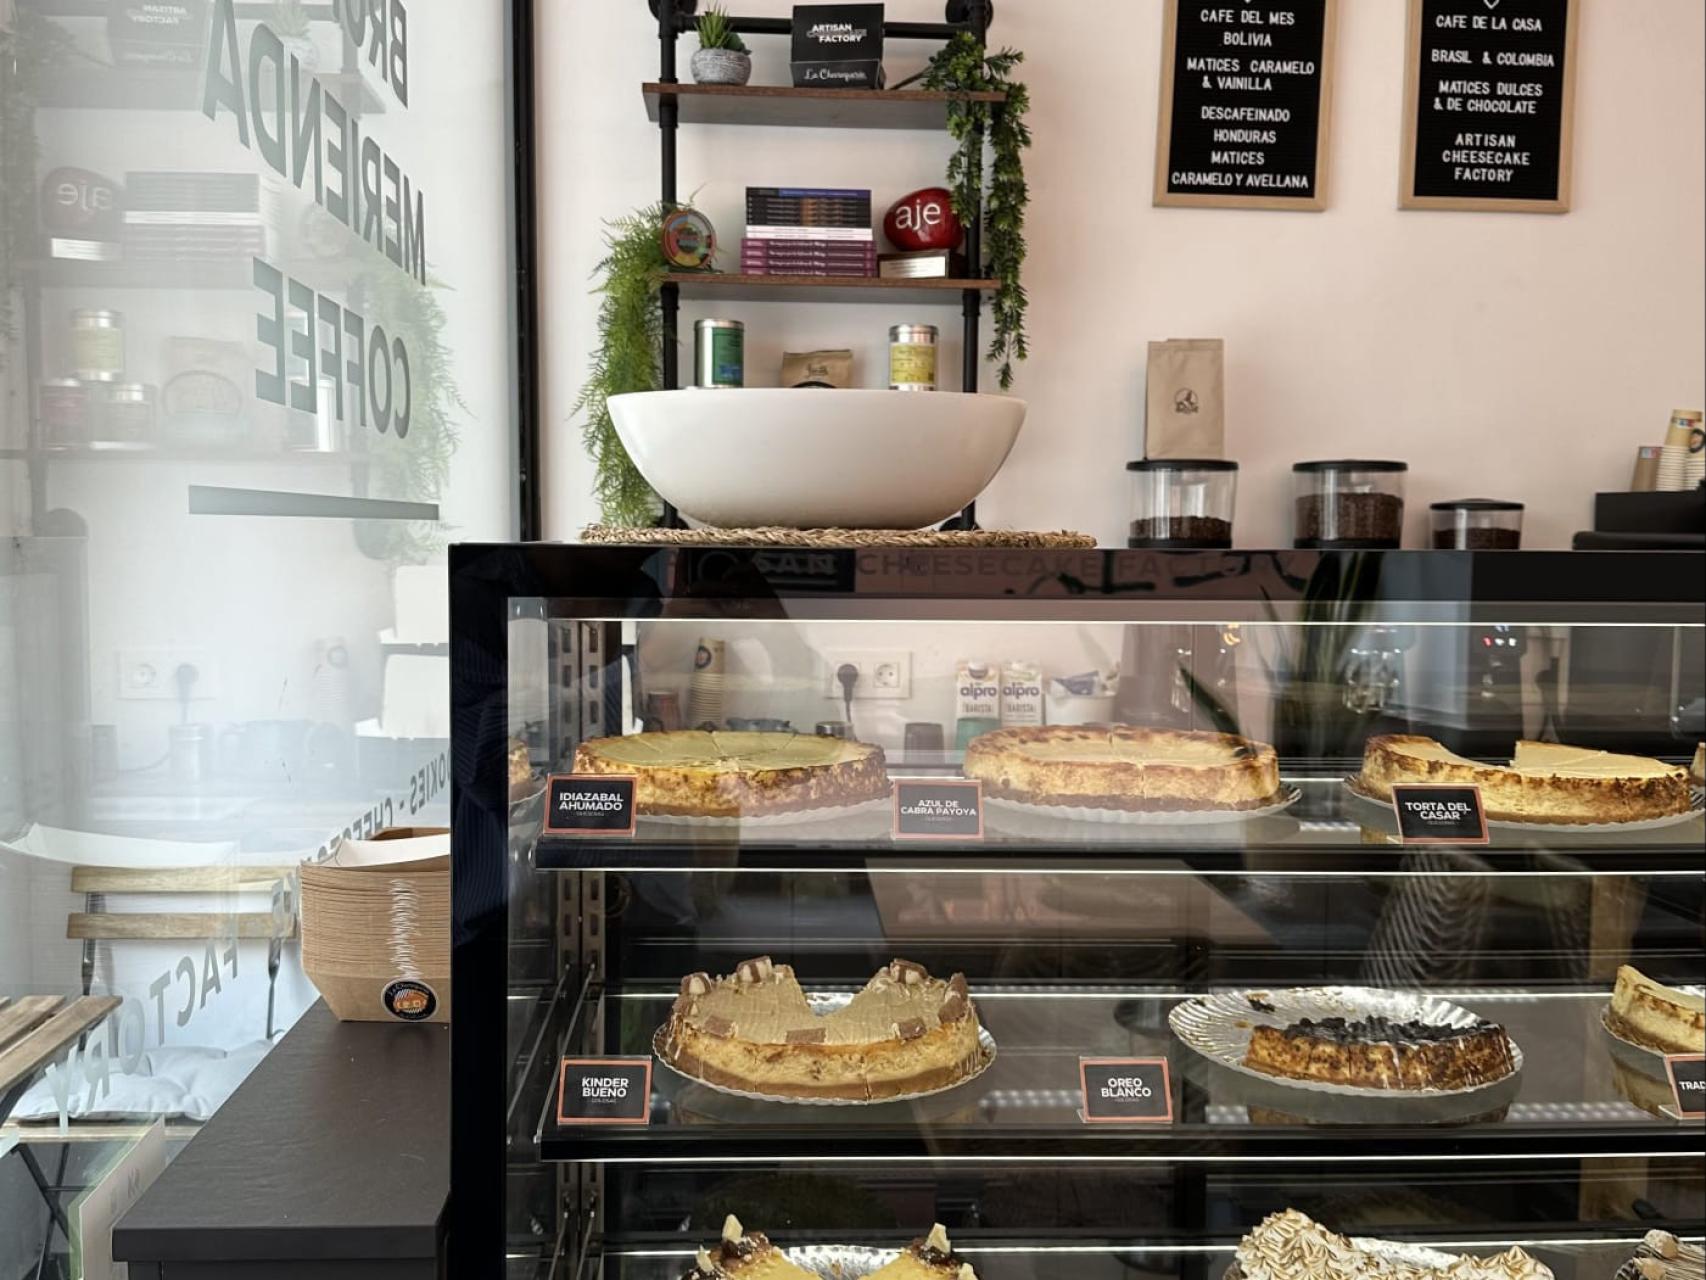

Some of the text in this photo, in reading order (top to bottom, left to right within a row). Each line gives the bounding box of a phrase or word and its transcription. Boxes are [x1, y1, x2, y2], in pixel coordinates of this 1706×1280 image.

[1200, 10, 1295, 25] CAFE DEL MES
[1436, 15, 1542, 32] CAFE DE LA CASA
[811, 23, 852, 32] ARTISAN
[819, 34, 862, 43] FACTORY
[1223, 32, 1272, 47] BOLIVIA
[1431, 49, 1555, 67] BRASIL & COLOMBIA
[1187, 57, 1315, 75] MATICES CARAMELO
[1202, 75, 1272, 91] & VAINILLA
[1438, 80, 1543, 96] MATICES DULCES
[1433, 97, 1536, 114] & DE CHOCOLATE
[1201, 106, 1291, 122] DESCAFEINADO
[1213, 128, 1277, 143] HONDURAS
[1455, 133, 1516, 148] ARTISAN
[1211, 151, 1265, 165] MATICES
[1442, 150, 1530, 166] CHEESECAKE
[1172, 172, 1309, 188] CARAMELO Y AVELLANA
[1454, 167, 1514, 182] FACTORY
[896, 199, 941, 230] aje
[960, 683, 997, 700] alpro
[1003, 682, 1040, 699] alpro
[560, 792, 624, 802] IDIAZABAL
[918, 799, 959, 808] AZUL DE
[559, 801, 623, 811] AHUMADO
[900, 806, 977, 816] CABRA PAYOYA
[1405, 802, 1472, 811] TORTA DEL
[1420, 811, 1460, 820] CASAR
[581, 1077, 629, 1088] KINDER
[1107, 1077, 1142, 1088] OREO
[582, 1087, 627, 1097] BUENO
[1101, 1087, 1152, 1097] BLANCO
